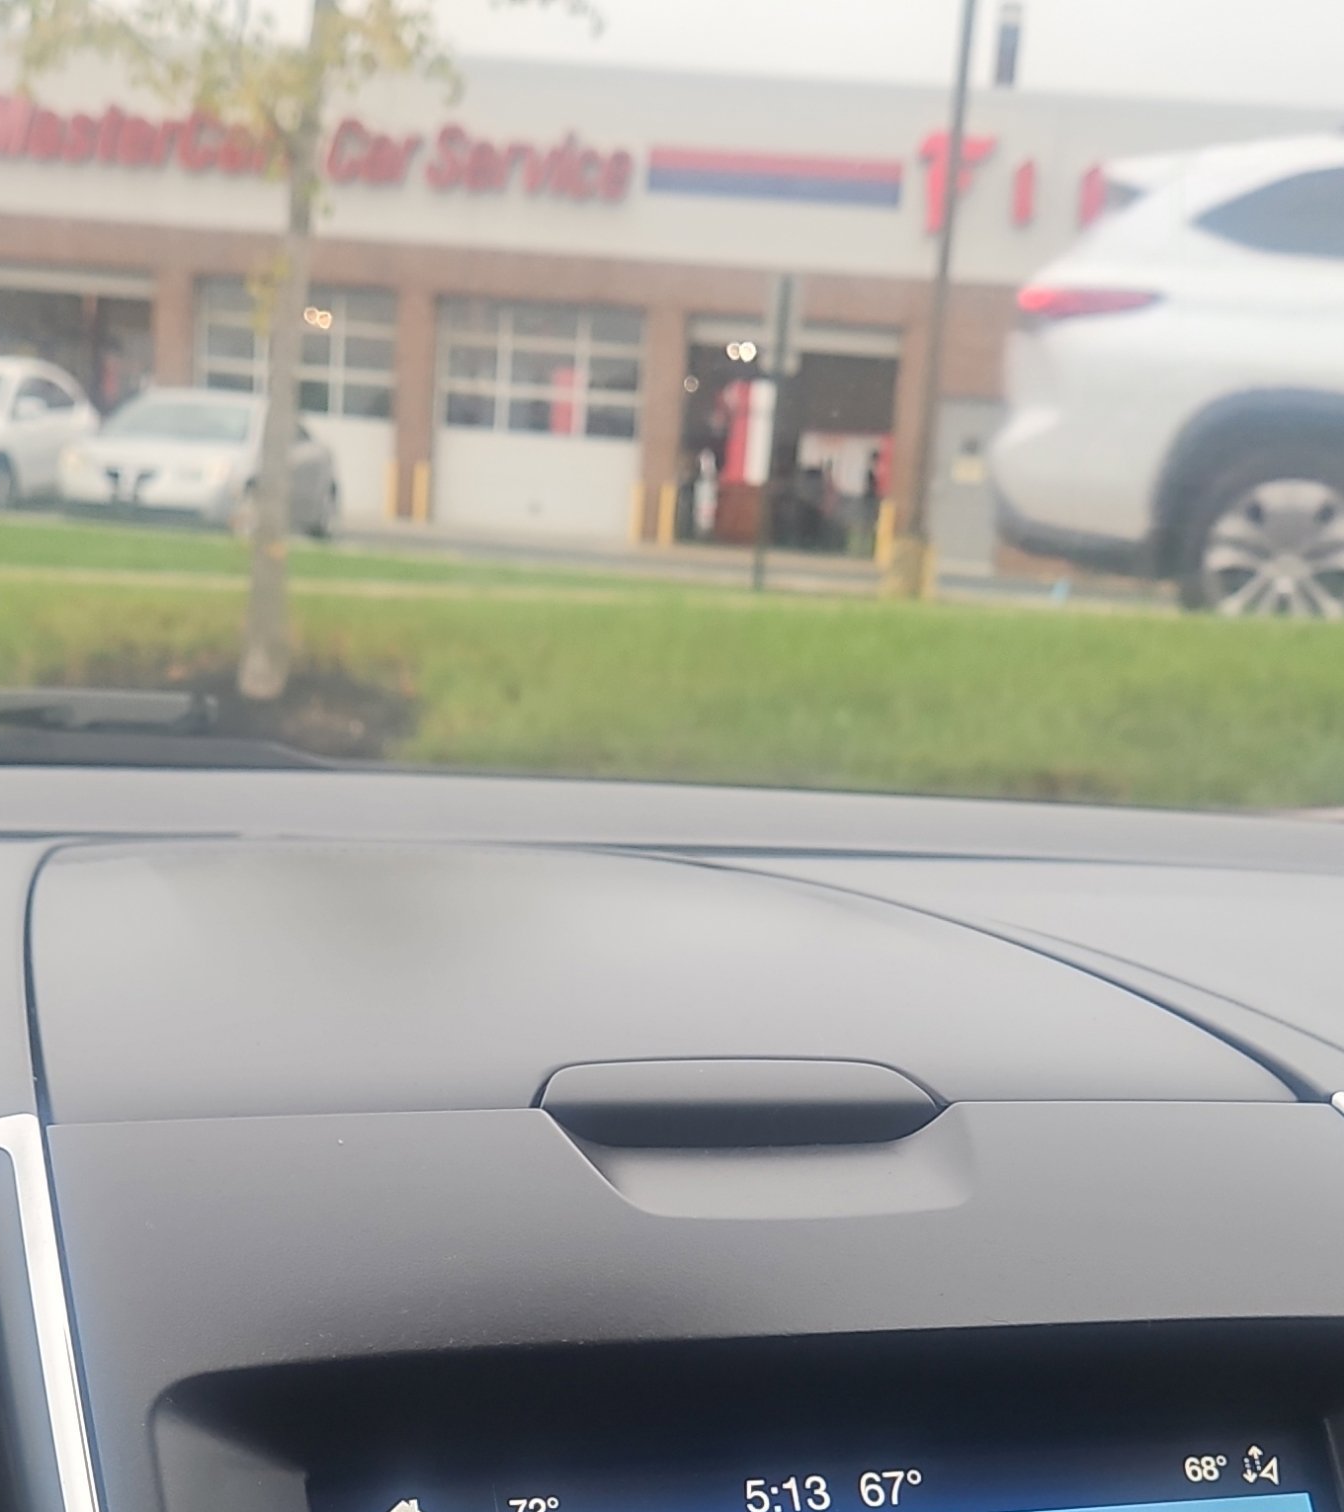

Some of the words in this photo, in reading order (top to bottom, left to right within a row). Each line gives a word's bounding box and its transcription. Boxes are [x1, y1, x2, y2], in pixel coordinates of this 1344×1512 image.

[326, 118, 422, 186] Car
[425, 123, 635, 206] Service
[1183, 1454, 1228, 1483] 68°
[858, 1470, 923, 1508] 67°
